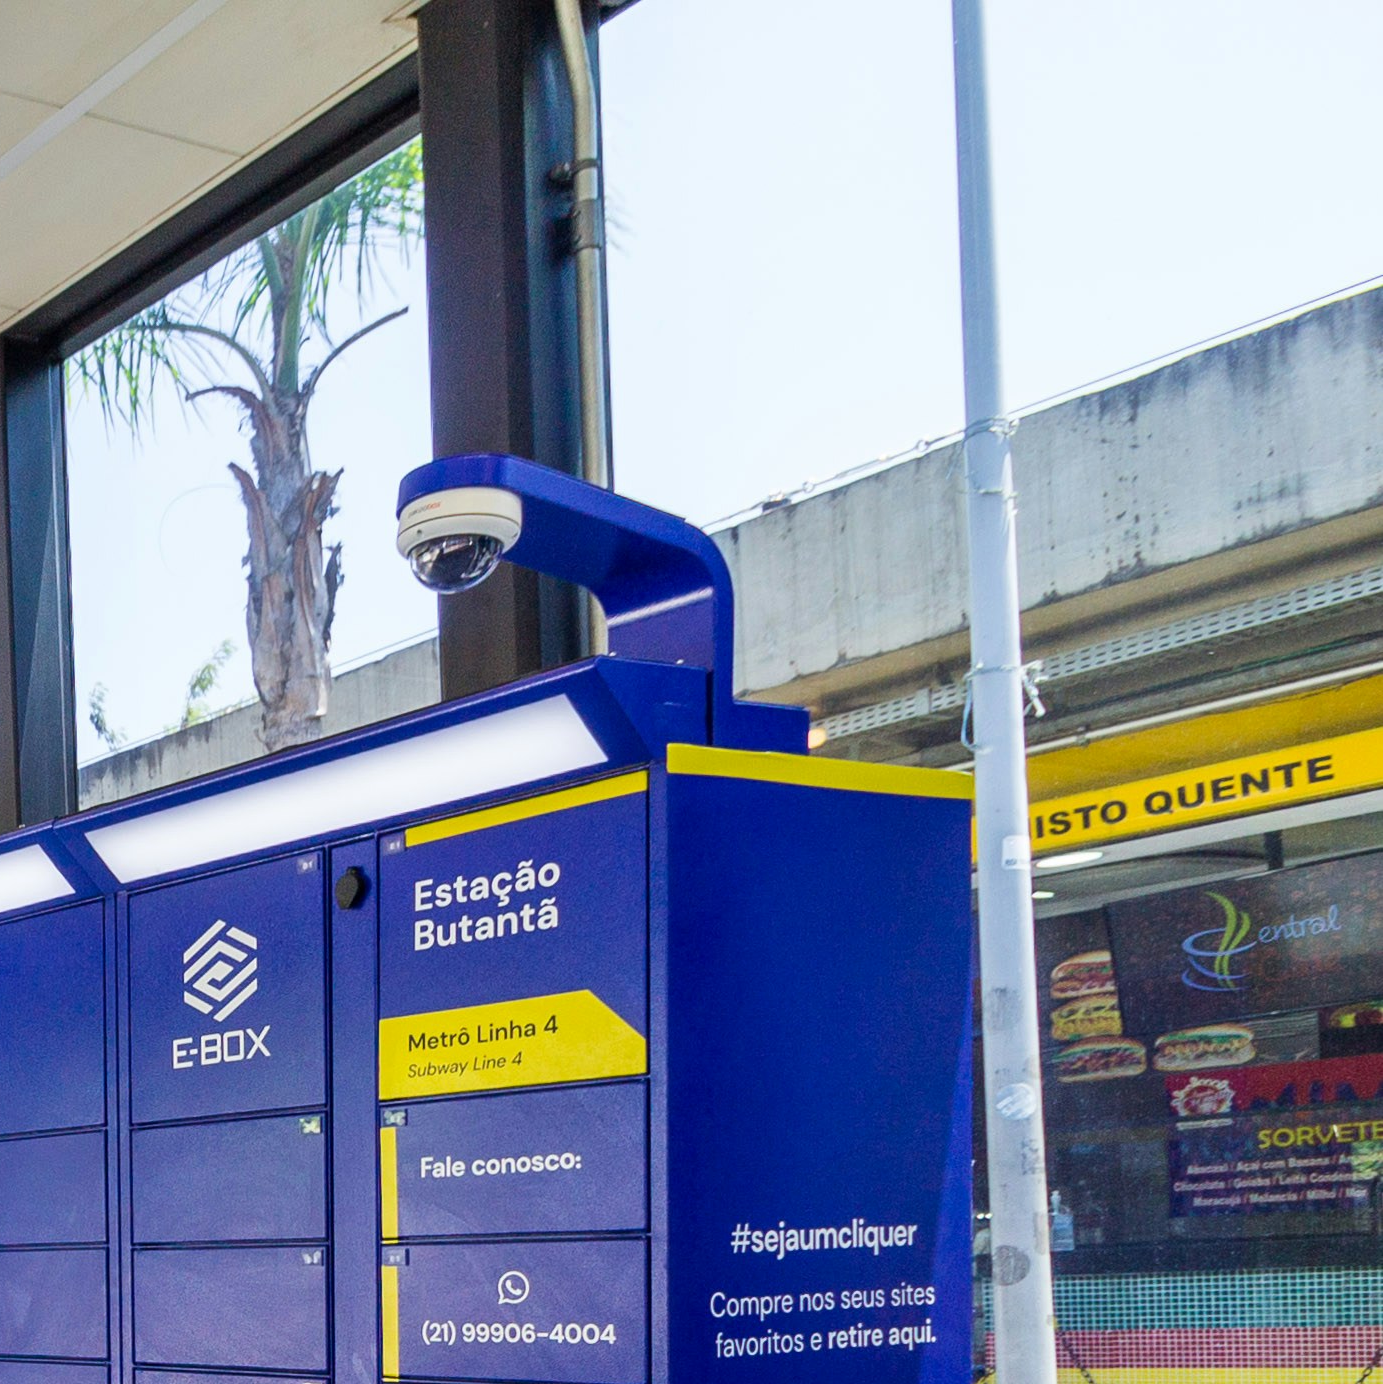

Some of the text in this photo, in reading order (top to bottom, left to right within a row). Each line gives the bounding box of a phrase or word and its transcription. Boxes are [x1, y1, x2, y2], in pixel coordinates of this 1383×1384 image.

[1030, 756, 1335, 839] ISTO QUENTE
[413, 861, 560, 912] Estação
[413, 900, 559, 951] Butantã
[172, 1025, 271, 1070] E-BOX
[407, 1015, 558, 1053] Metrô Linha 4
[407, 1052, 523, 1081] Subway Line 4
[420, 1150, 582, 1178] Fale conosco:
[730, 1218, 918, 1261] #sejaumcliquer
[709, 1281, 936, 1322] Compre nos seus sites
[421, 1320, 617, 1346] (21) 99906-4004
[715, 1319, 937, 1358] favoritos e retire aqui.
